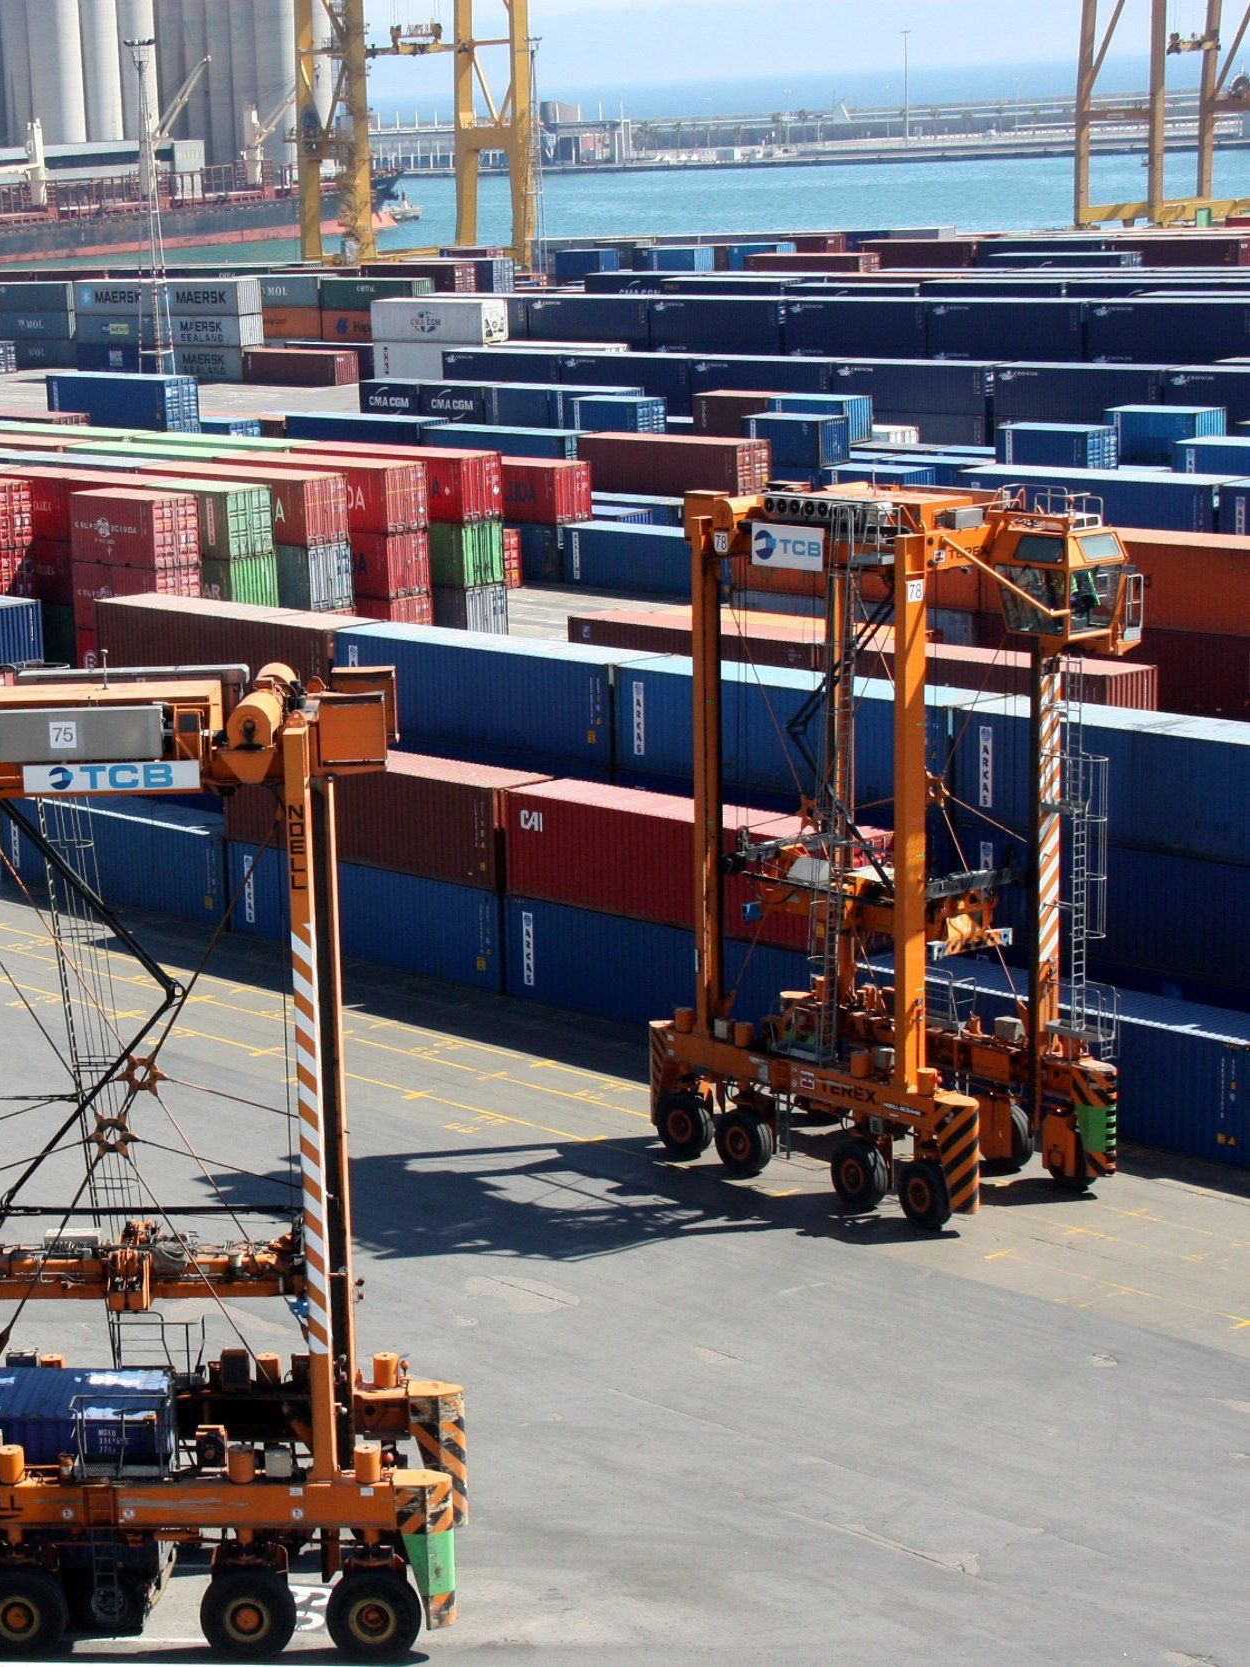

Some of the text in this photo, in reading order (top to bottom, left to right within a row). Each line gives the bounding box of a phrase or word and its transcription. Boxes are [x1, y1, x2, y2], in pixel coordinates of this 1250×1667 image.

[95, 291, 141, 304] MAERSK
[176, 291, 226, 304] MAERSK
[268, 286, 288, 296] MOL
[180, 321, 222, 332] MAERSK
[180, 335, 223, 343] SEALAND
[182, 354, 224, 365] MAERSK
[369, 395, 409, 408] CMA CGM
[431, 399, 473, 411] CMA CGM
[715, 534, 727, 550] 78
[779, 539, 821, 556] TCB
[909, 583, 923, 598] 78
[635, 698, 643, 754] ARKAS
[52, 727, 73, 742] 75
[80, 764, 173, 789] TCB
[982, 745, 990, 806] ARKAS
[520, 809, 543, 832] CAI
[289, 805, 306, 890] NOELL
[525, 929, 533, 984] ARKAS
[820, 1081, 876, 1104] TEREX
